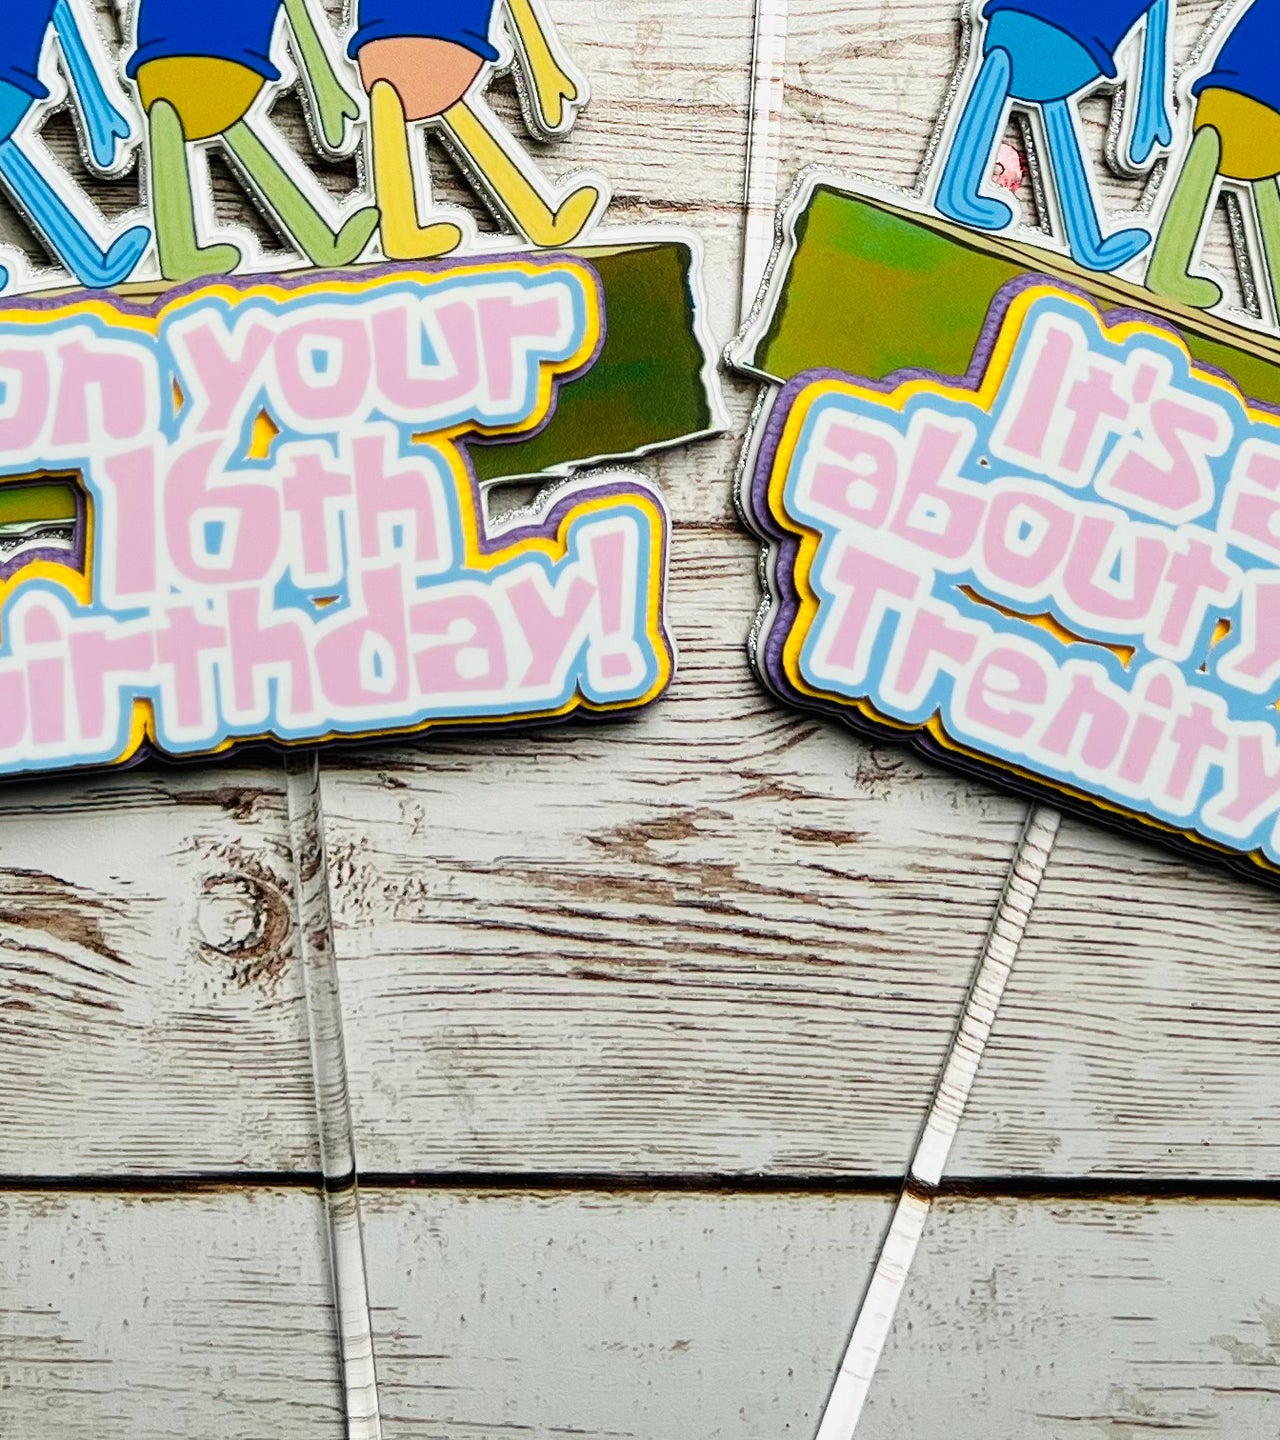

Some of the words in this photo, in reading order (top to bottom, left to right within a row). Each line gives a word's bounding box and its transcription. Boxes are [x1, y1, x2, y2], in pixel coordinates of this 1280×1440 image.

[184, 298, 561, 432] your
[1006, 329, 1218, 510] It's
[105, 436, 438, 595] 16th
[811, 424, 1230, 659] about
